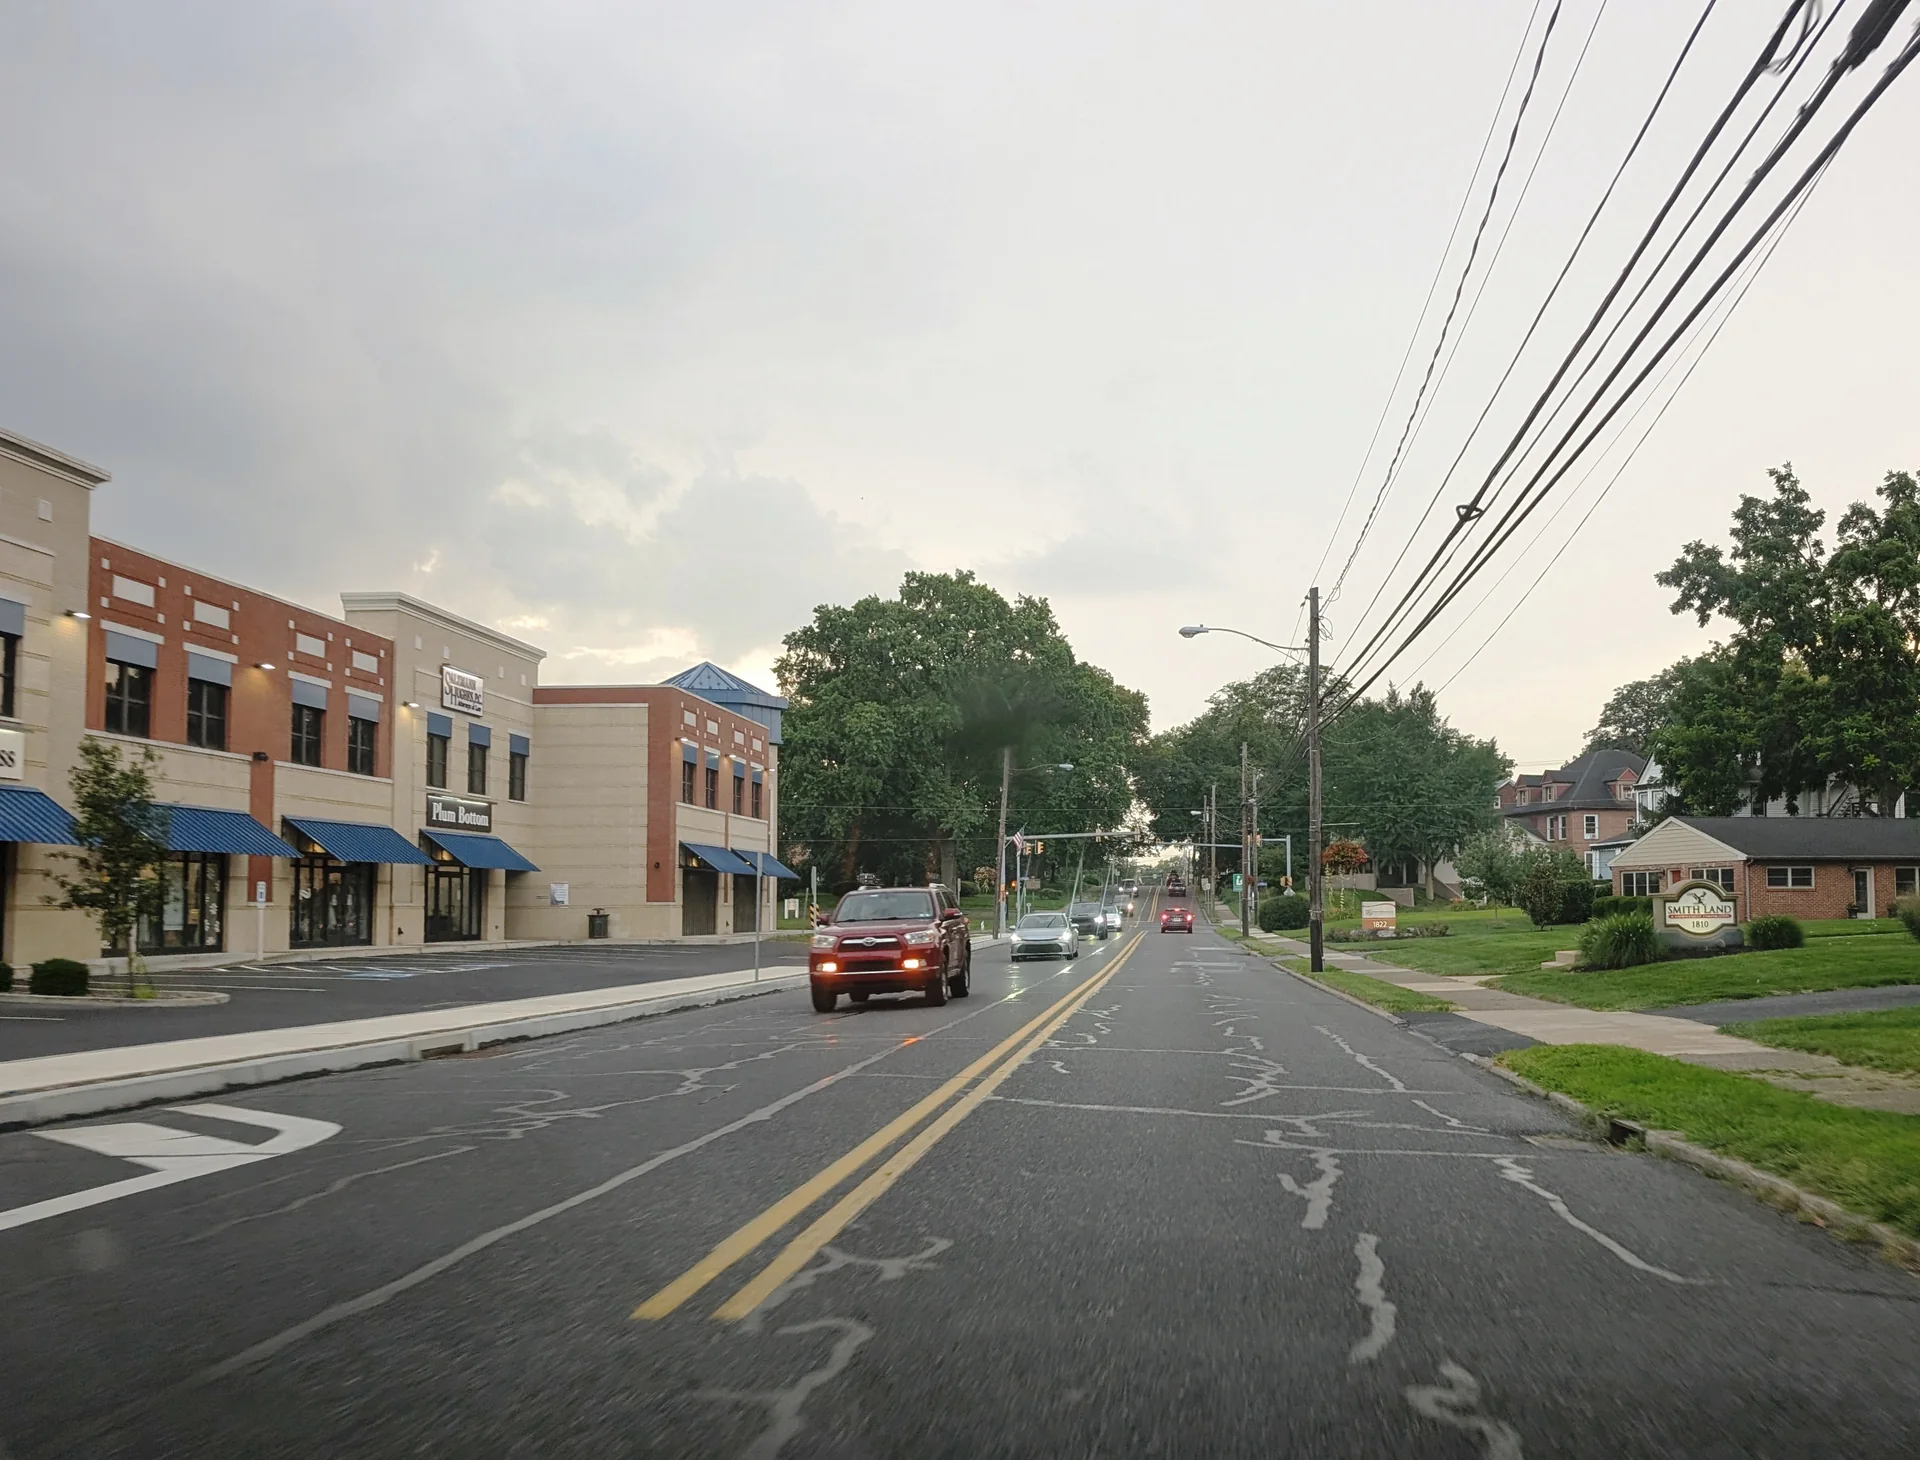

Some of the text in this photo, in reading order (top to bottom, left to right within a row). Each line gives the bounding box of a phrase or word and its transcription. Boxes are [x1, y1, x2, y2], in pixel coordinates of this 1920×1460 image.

[432, 802, 489, 827] Plum Bottom
[1668, 905, 1732, 914] SMITH LAND
